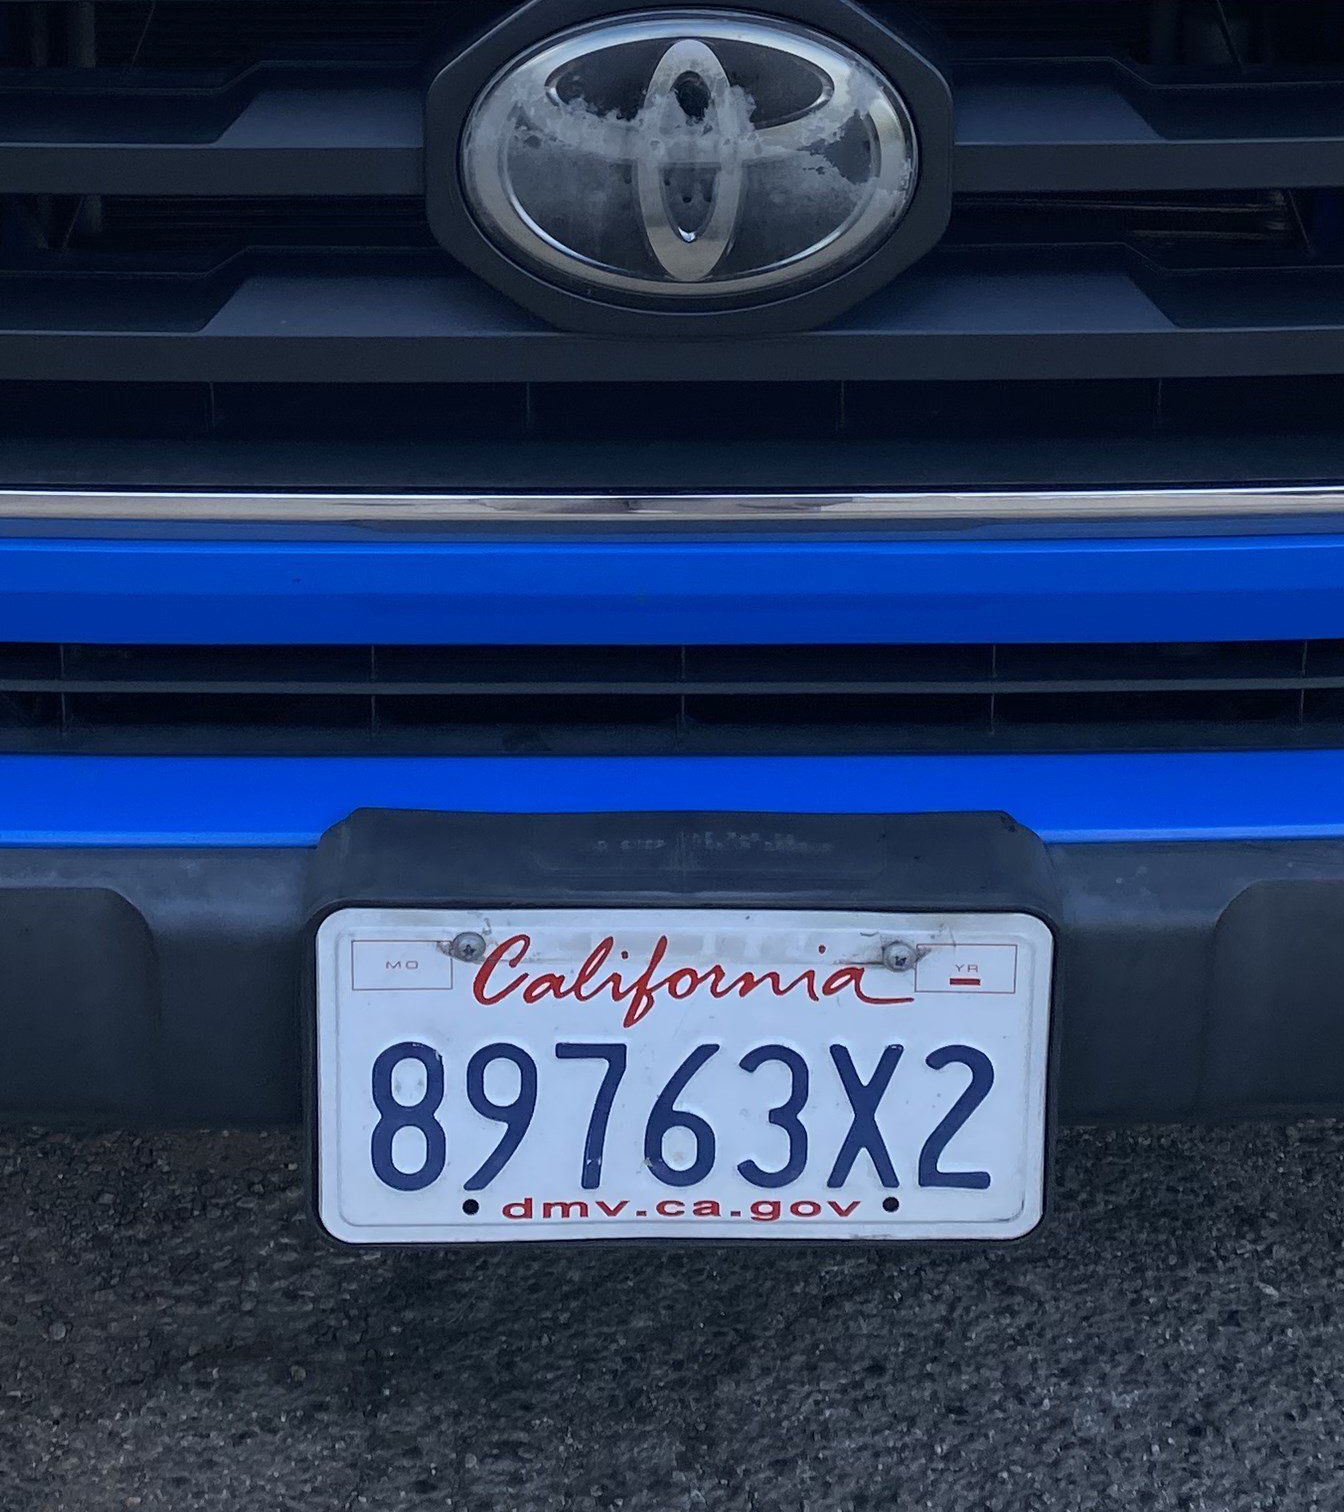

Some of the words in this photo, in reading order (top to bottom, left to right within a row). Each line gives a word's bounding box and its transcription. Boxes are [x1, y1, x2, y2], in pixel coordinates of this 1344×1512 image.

[385, 960, 419, 969] MO
[472, 934, 914, 1028] California
[955, 963, 979, 973] YR
[371, 1042, 995, 1192] 89763X2
[502, 1197, 862, 1221] dmv.ca.gov
